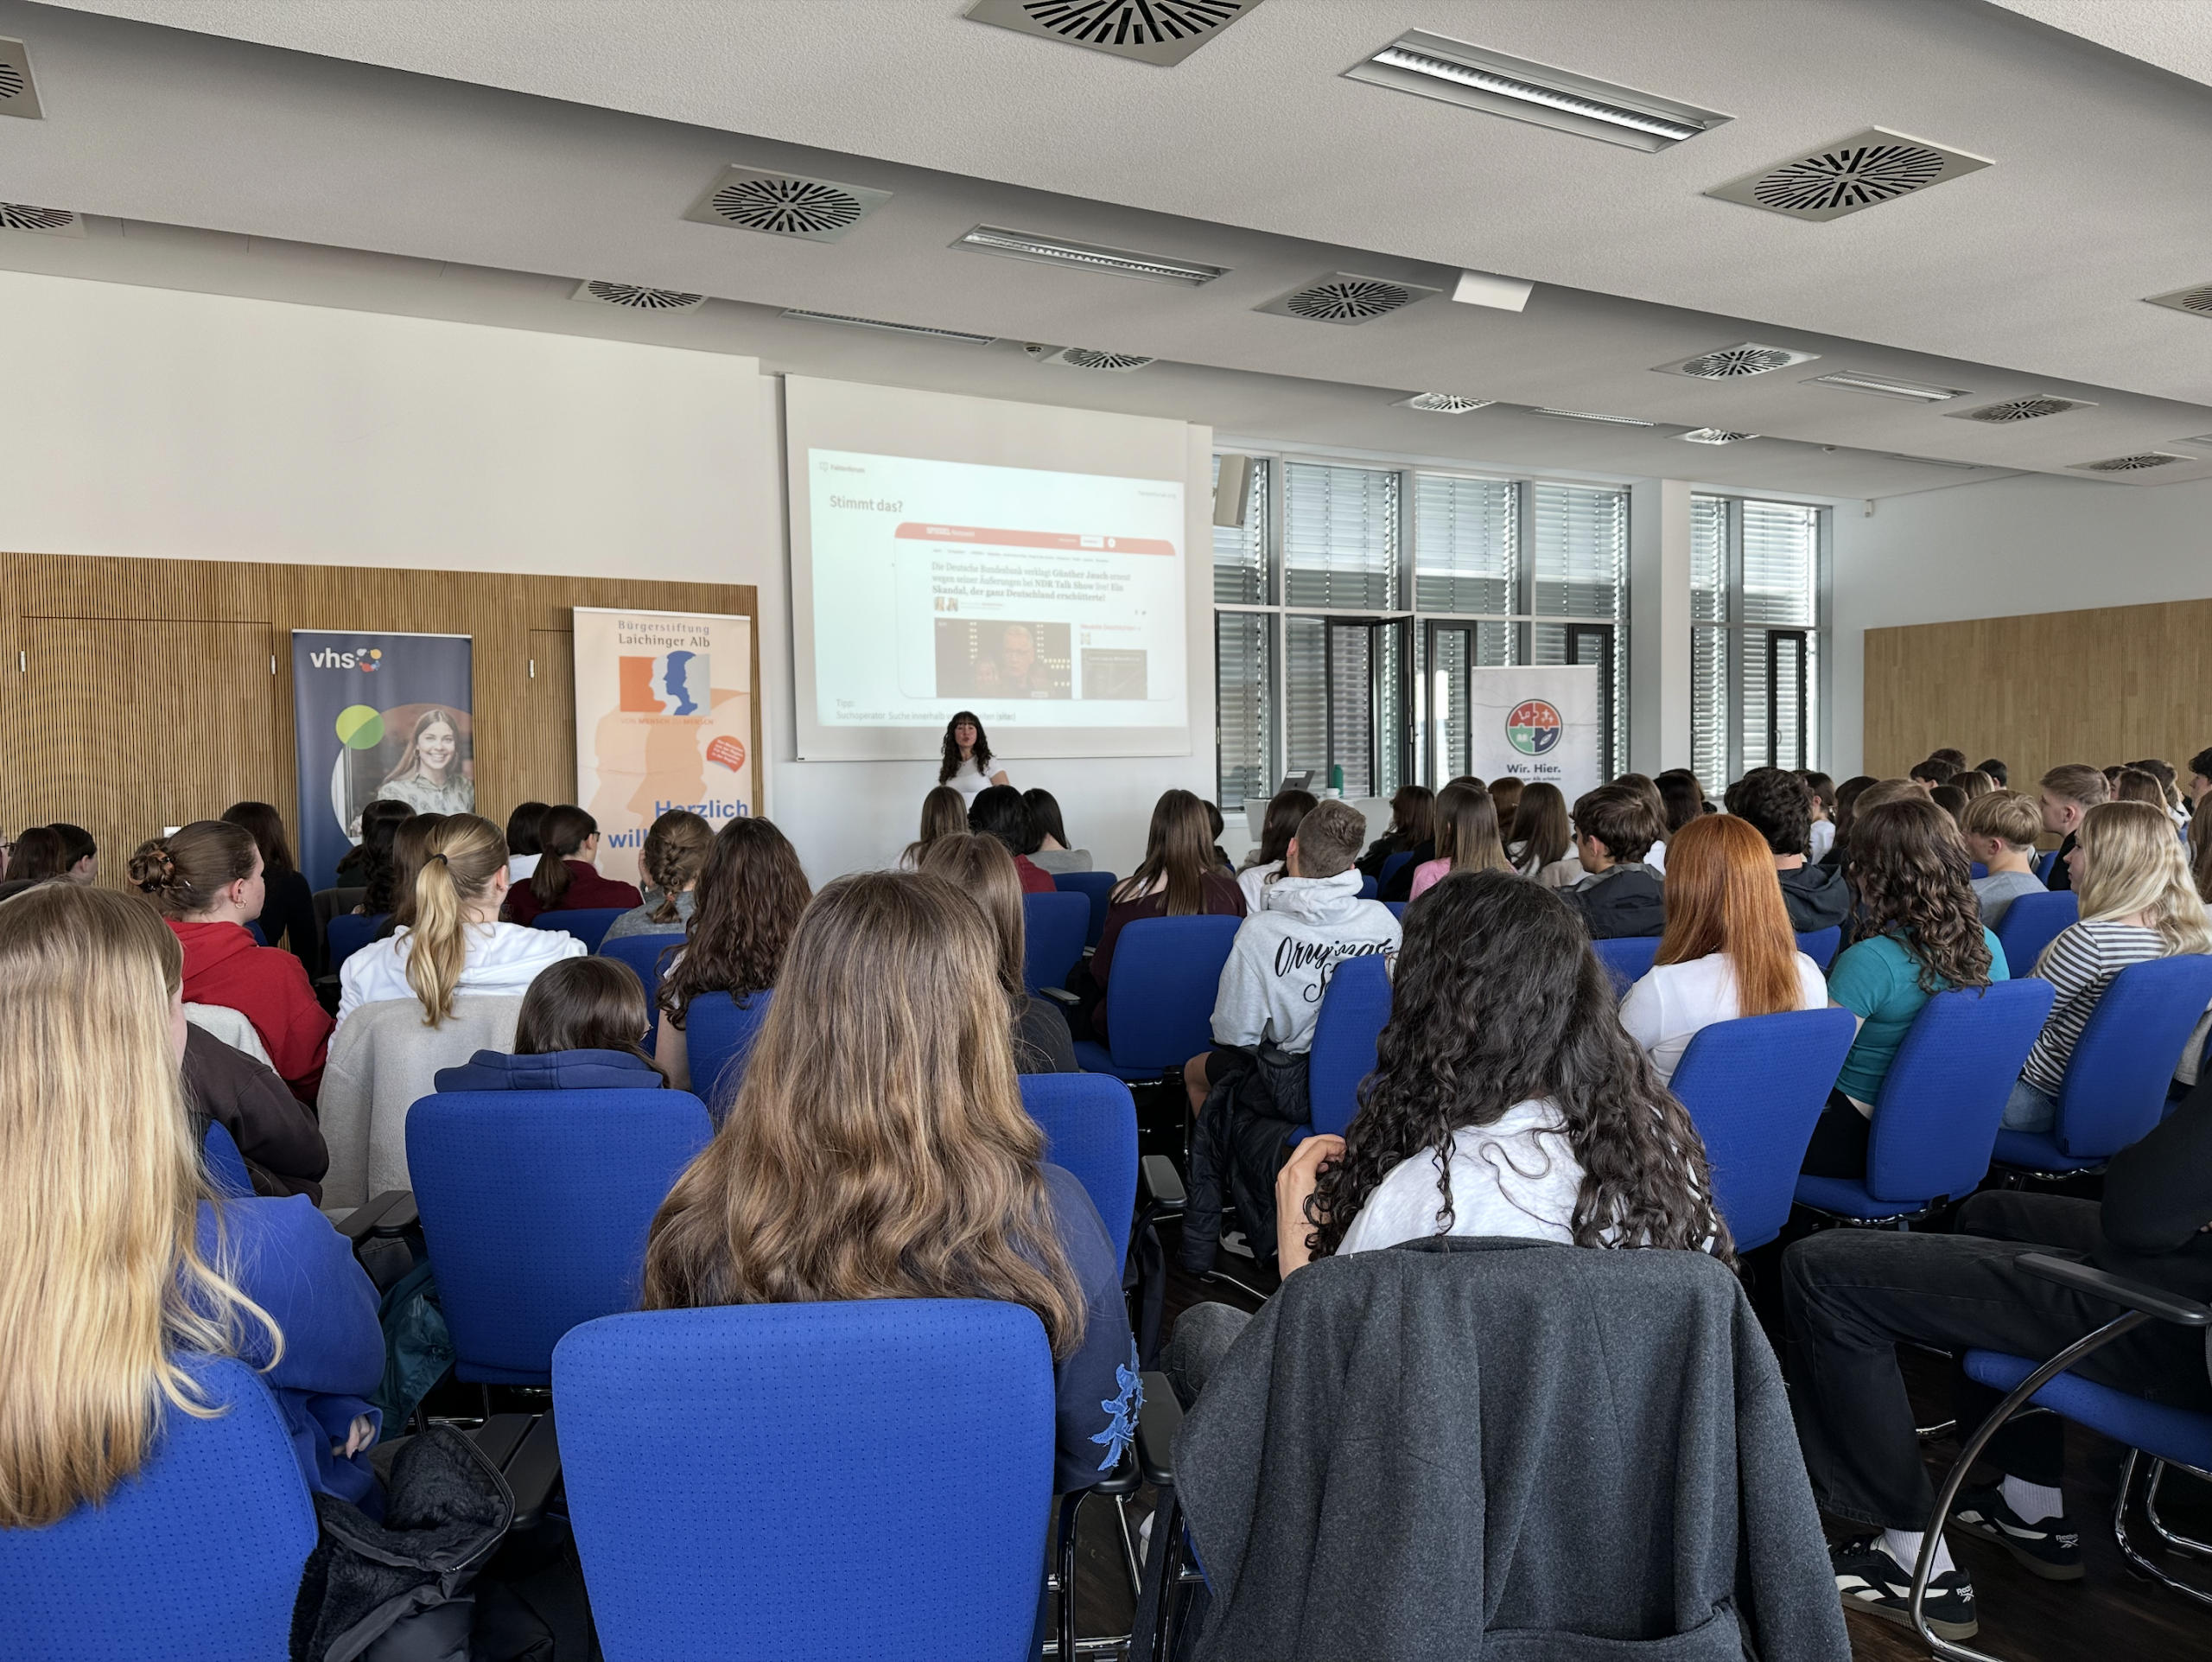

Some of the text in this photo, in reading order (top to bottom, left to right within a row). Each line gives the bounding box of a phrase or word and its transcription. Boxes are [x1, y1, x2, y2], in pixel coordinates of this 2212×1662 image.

[830, 494, 903, 513] Stimmt das?
[932, 562, 1131, 582] Die Deutsche Bundesbank verklagt Günther Jauch erneut
[932, 576, 955, 584] wegen
[957, 574, 978, 584] seiner
[979, 575, 1021, 588] Äußerungen
[1023, 577, 1033, 587] bei
[1034, 580, 1053, 589] NDR
[1054, 580, 1071, 589] Talk
[1073, 581, 1094, 590] Show
[1110, 583, 1124, 592] Ein
[932, 585, 969, 596] Skandal,
[969, 587, 984, 595] der
[1006, 589, 1055, 599] Deutschland
[1057, 591, 1106, 602] erschütterte!
[618, 620, 709, 635] Bürgerstiftung
[619, 634, 710, 648] Laichinger Alb
[309, 647, 355, 669] vhs
[836, 698, 855, 709] Tipp:
[836, 710, 886, 722] Suchoperator
[888, 711, 911, 720] Suche
[912, 711, 945, 720] innerhalb
[1506, 763, 1561, 774] Wir. Hier.
